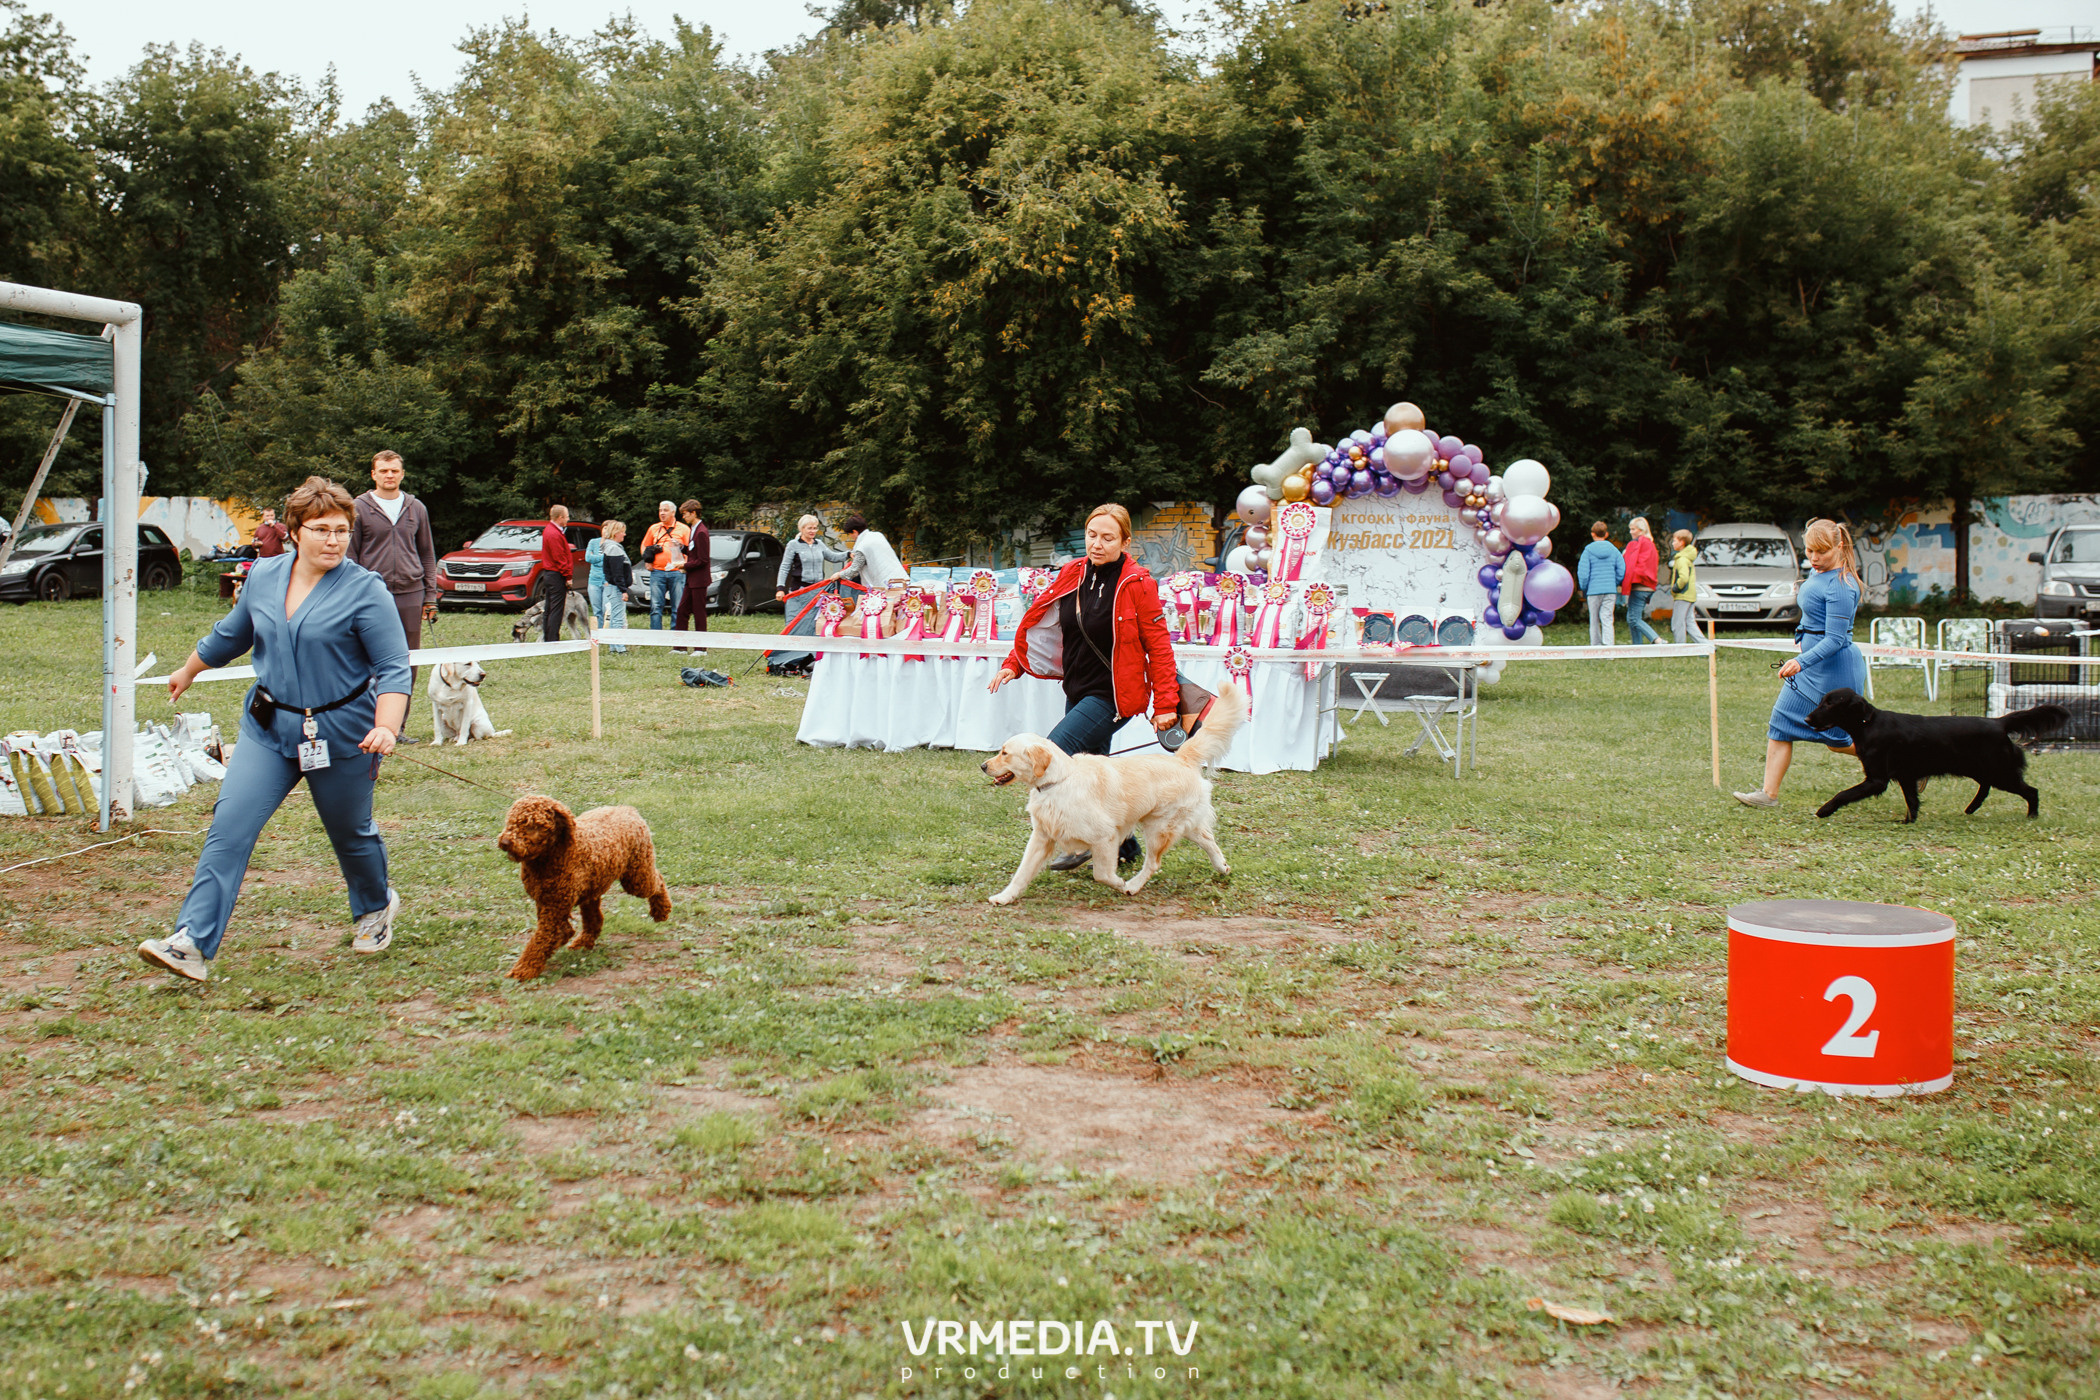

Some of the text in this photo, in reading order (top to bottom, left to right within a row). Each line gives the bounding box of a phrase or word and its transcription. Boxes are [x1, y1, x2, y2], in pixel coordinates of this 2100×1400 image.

[1327, 529, 1455, 552] Кузбасс 2021
[303, 745, 322, 758] 222
[1821, 975, 1880, 1058] 2
